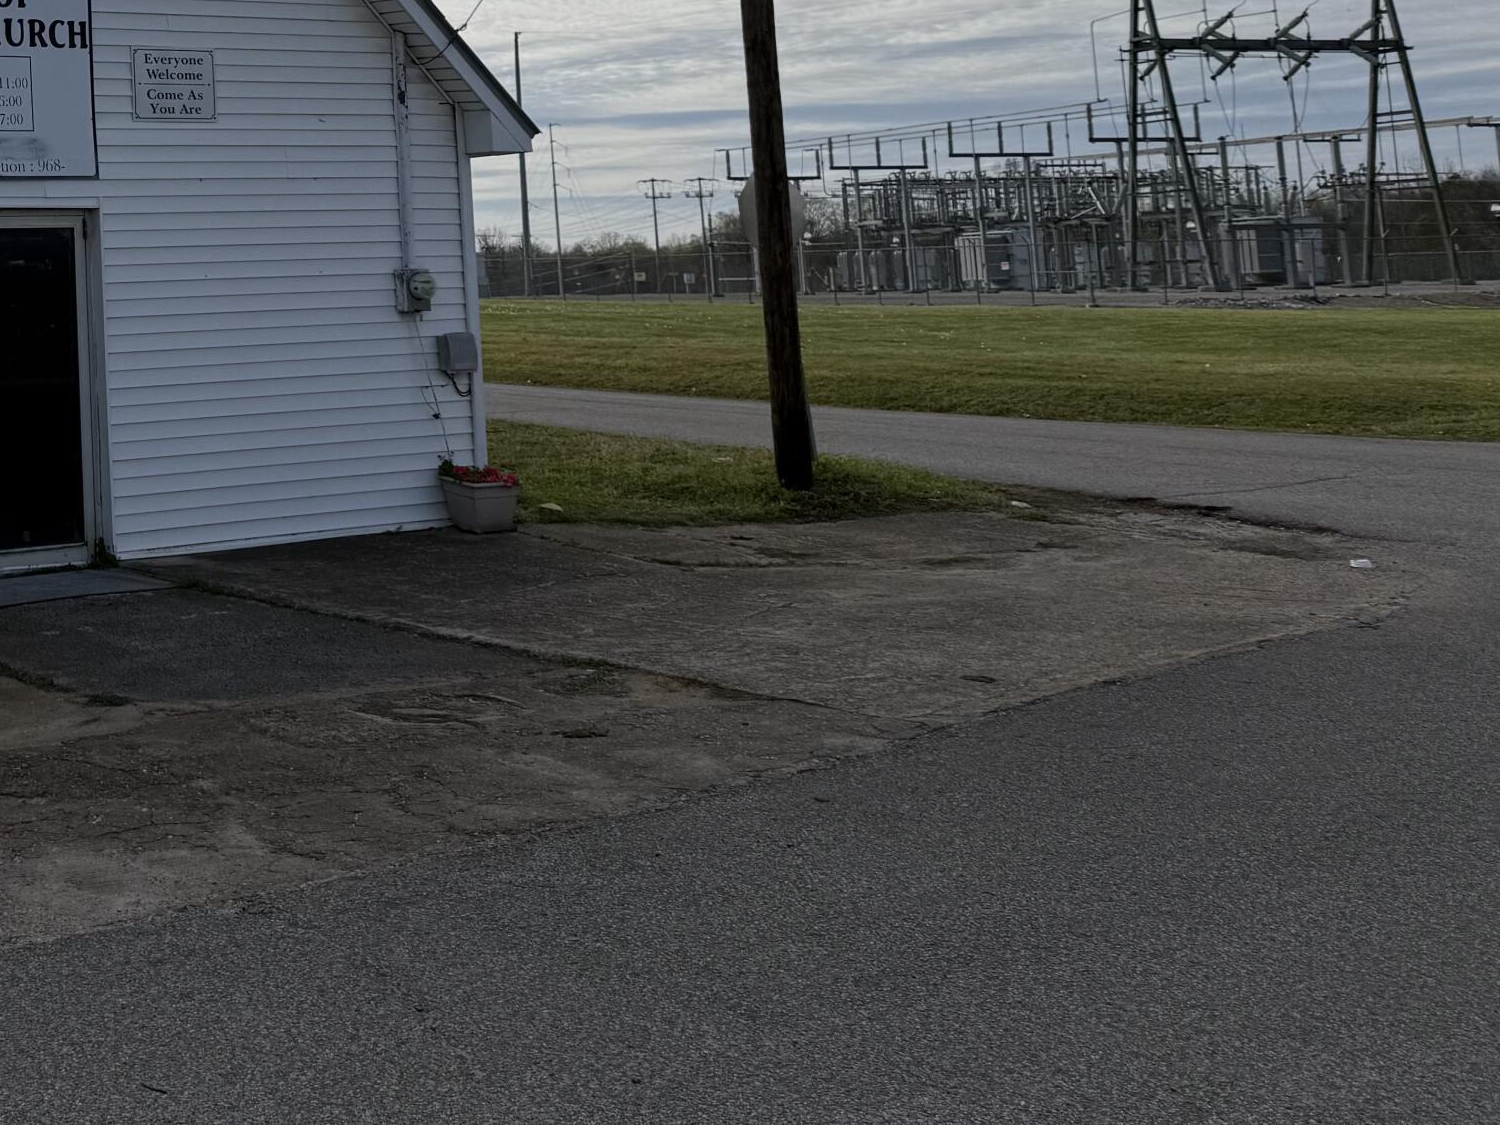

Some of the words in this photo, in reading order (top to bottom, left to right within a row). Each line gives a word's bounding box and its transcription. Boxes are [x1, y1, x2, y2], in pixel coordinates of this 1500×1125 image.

[144, 53, 204, 68] Everyone
[146, 68, 203, 80] Welcome
[147, 88, 184, 100] Come
[187, 89, 204, 100] As
[149, 103, 175, 114] You
[180, 103, 202, 114] Are
[0, 113, 24, 125] 7:00
